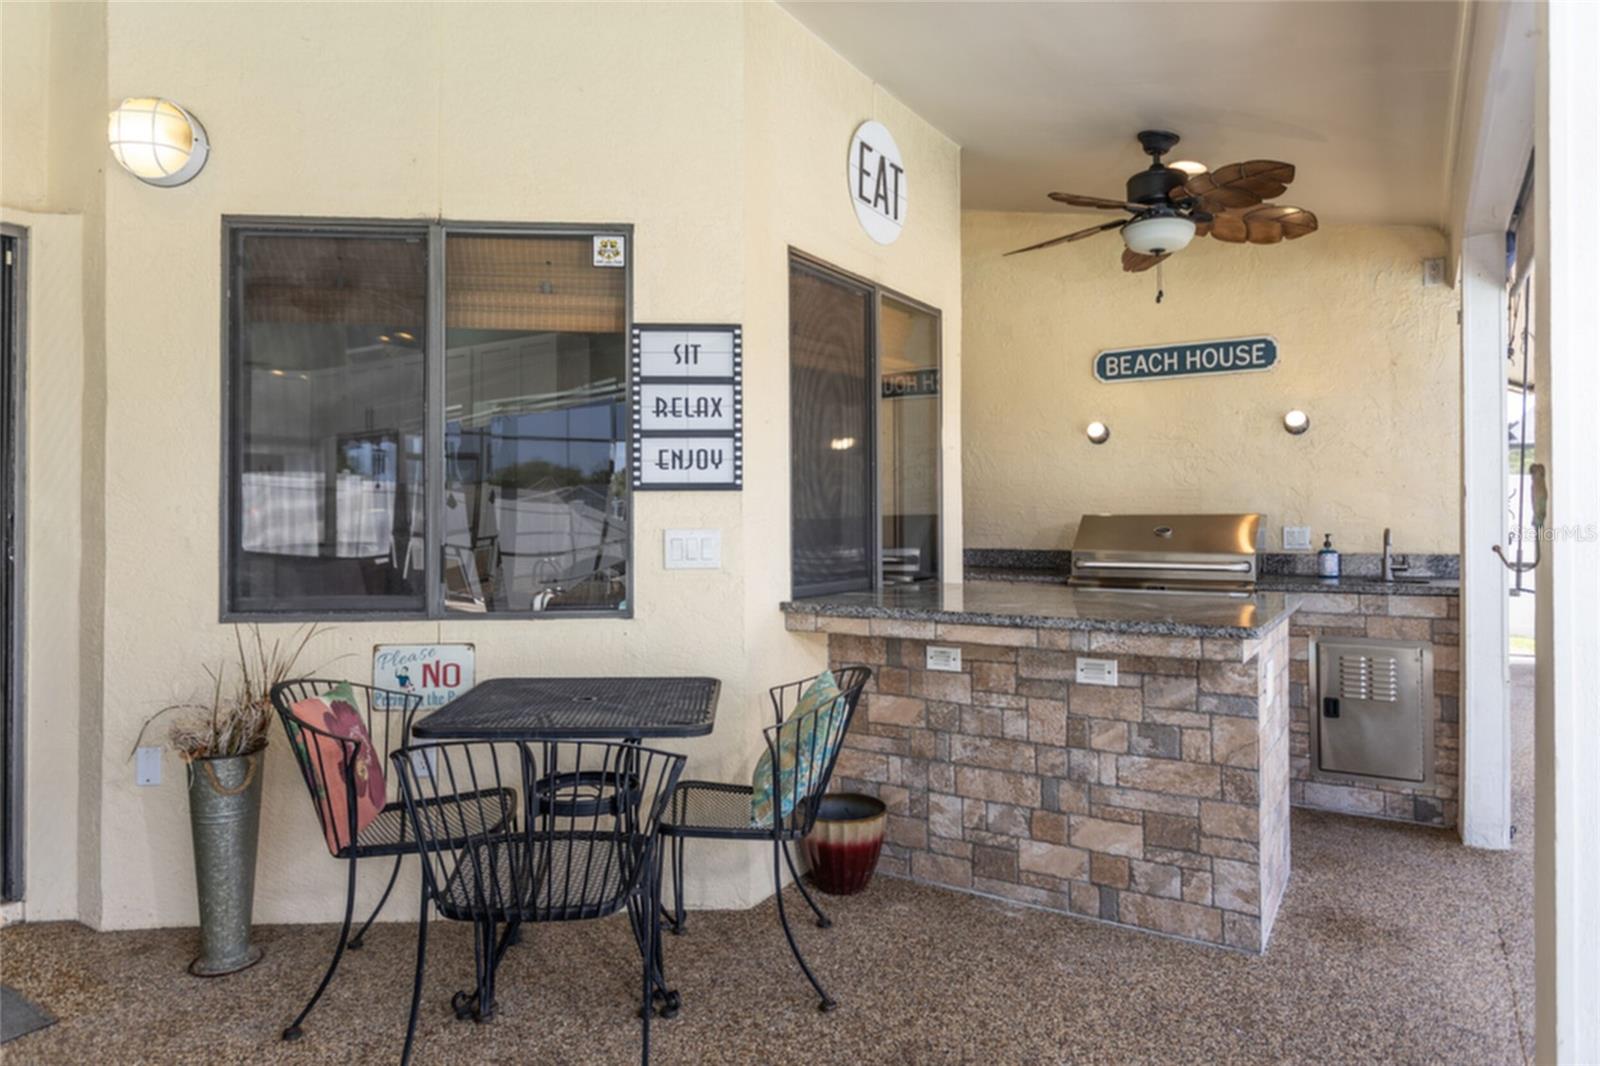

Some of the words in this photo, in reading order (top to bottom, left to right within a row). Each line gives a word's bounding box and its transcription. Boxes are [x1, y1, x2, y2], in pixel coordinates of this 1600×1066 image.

[859, 141, 903, 220] EAT
[673, 344, 701, 365] SIT
[1105, 352, 1178, 377] BEACH
[1186, 343, 1266, 370] HOUSE
[652, 397, 723, 418] RELAX
[655, 449, 723, 470] ENJOY
[377, 648, 437, 670] Please
[421, 660, 462, 689] NO
